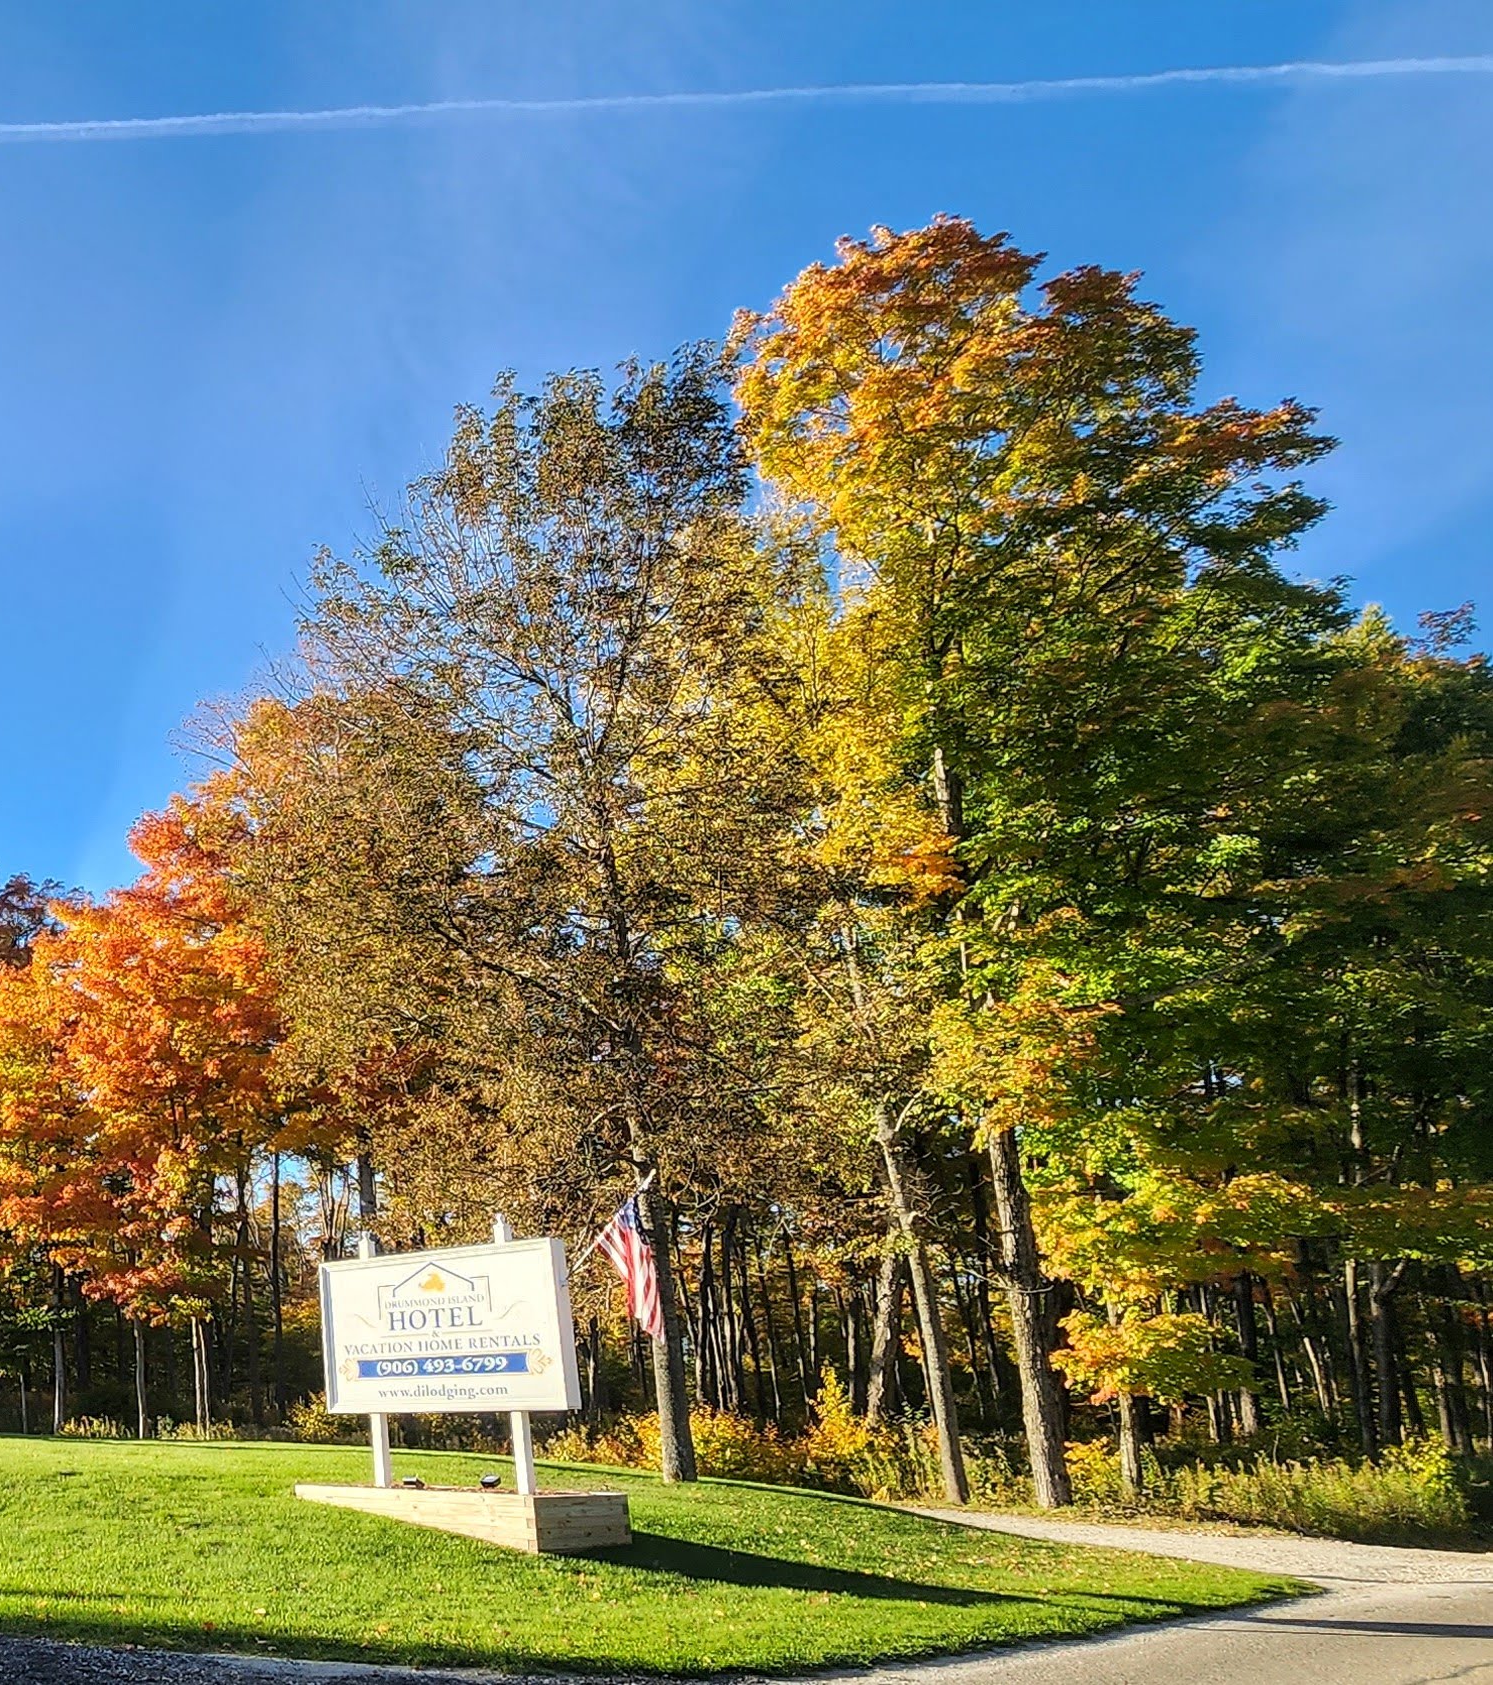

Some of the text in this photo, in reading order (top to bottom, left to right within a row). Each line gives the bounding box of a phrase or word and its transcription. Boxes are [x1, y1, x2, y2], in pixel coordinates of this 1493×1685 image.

[448, 1294, 484, 1305] ISLAND
[389, 1306, 483, 1331] HOTEL
[431, 1330, 440, 1338] &
[344, 1333, 541, 1356] VACATION HOME RENTALS
[376, 1356, 508, 1376] (906) 493-6799
[378, 1384, 508, 1401] www.dilodging.com
